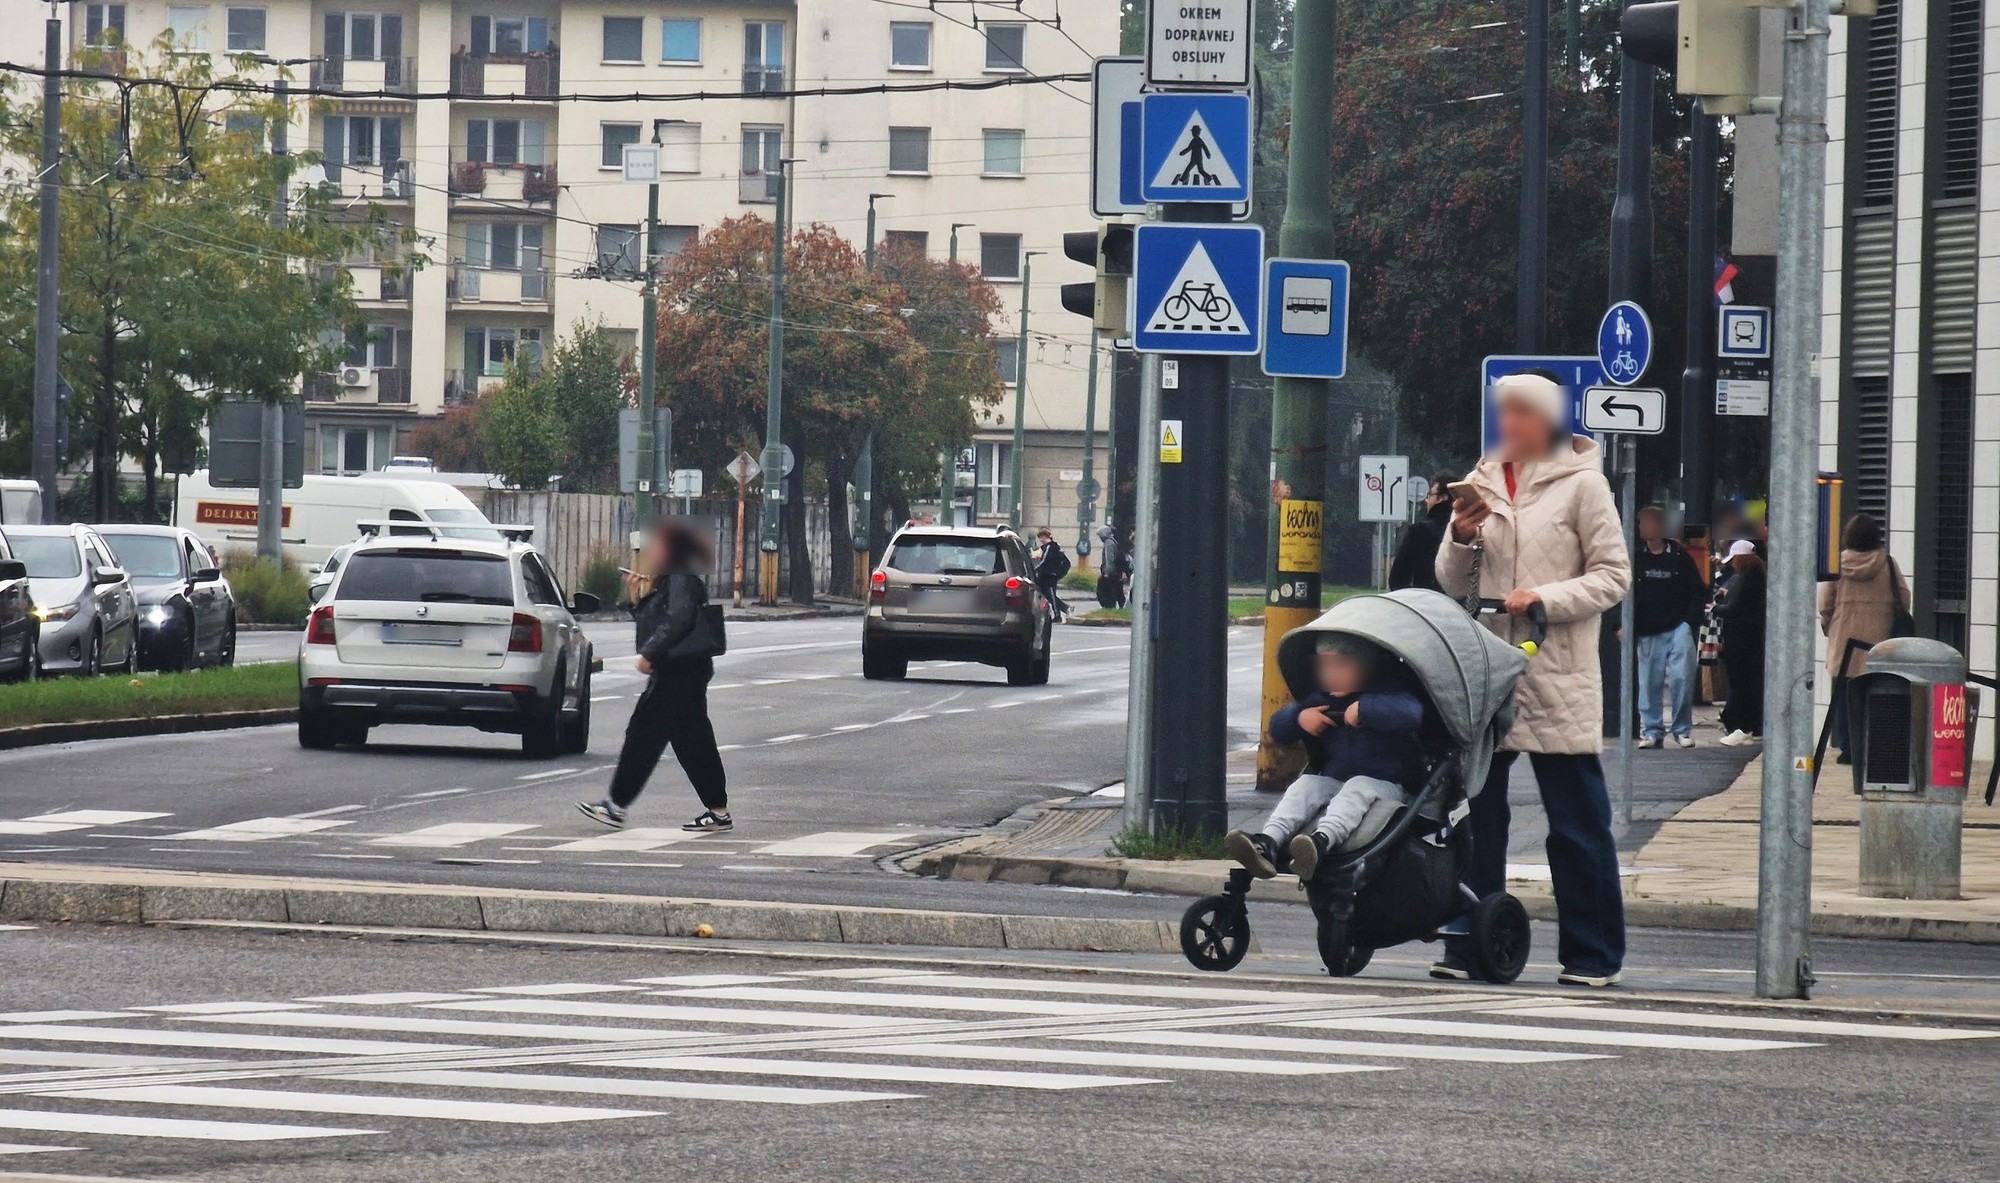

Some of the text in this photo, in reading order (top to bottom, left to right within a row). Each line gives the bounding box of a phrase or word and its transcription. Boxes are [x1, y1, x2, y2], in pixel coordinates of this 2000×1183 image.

[1179, 7, 1221, 20] OKREM
[1165, 28, 1235, 42] DOPRAVNEJ
[1172, 51, 1226, 64] OBSLUHY
[204, 507, 259, 520] DELIKAT
